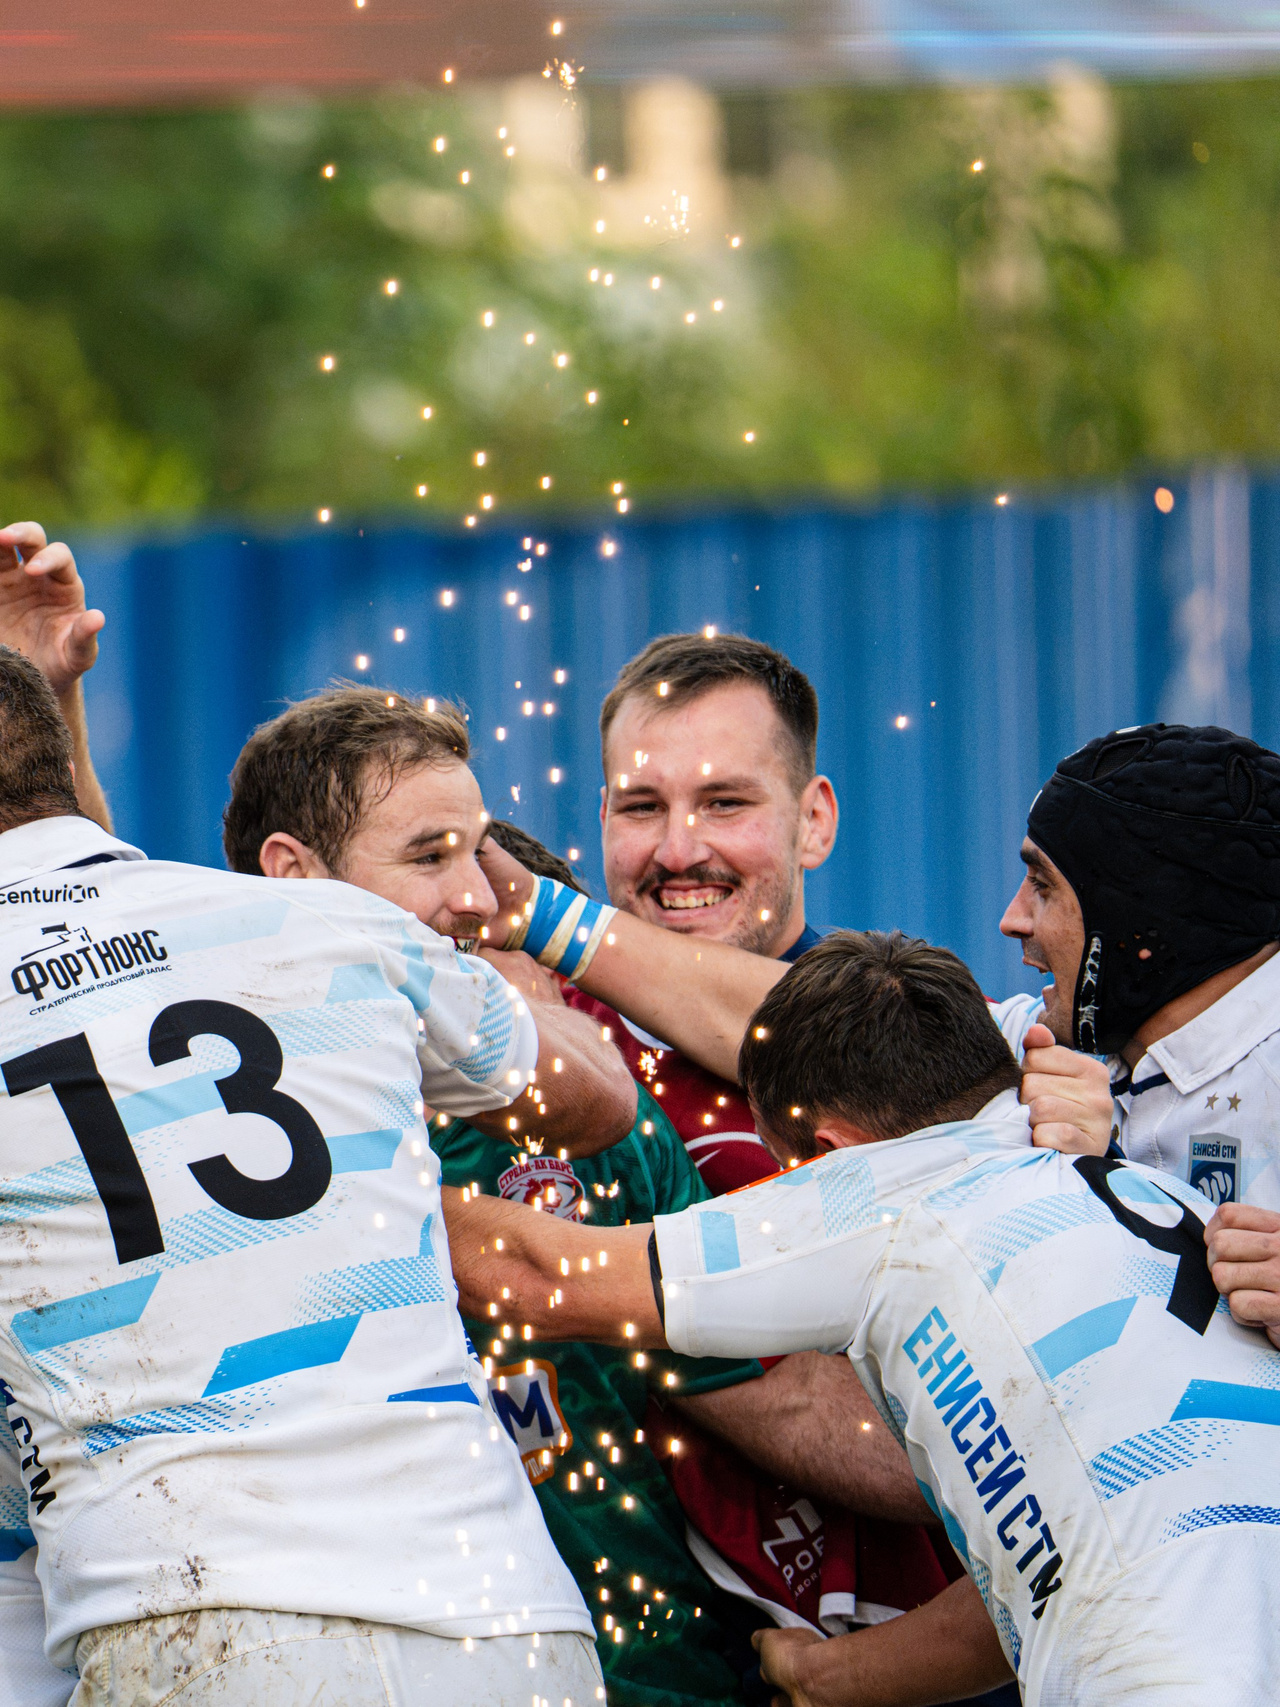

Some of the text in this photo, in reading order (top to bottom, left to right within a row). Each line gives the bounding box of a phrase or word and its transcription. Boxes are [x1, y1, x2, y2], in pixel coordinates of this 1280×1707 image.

[29, 964, 173, 1016] СТРАТЕГИЧЕСКИЙ ПРОДУКТОВЫЙ ЗАПАС
[0, 999, 333, 1265] 13
[548, 1159, 574, 1175] БАРС
[1192, 1140, 1237, 1160] ЕНИСЕЙ СТМ
[1072, 1155, 1221, 1337] 9
[902, 1305, 1063, 1621] ЕНИСЕЙ СТМ
